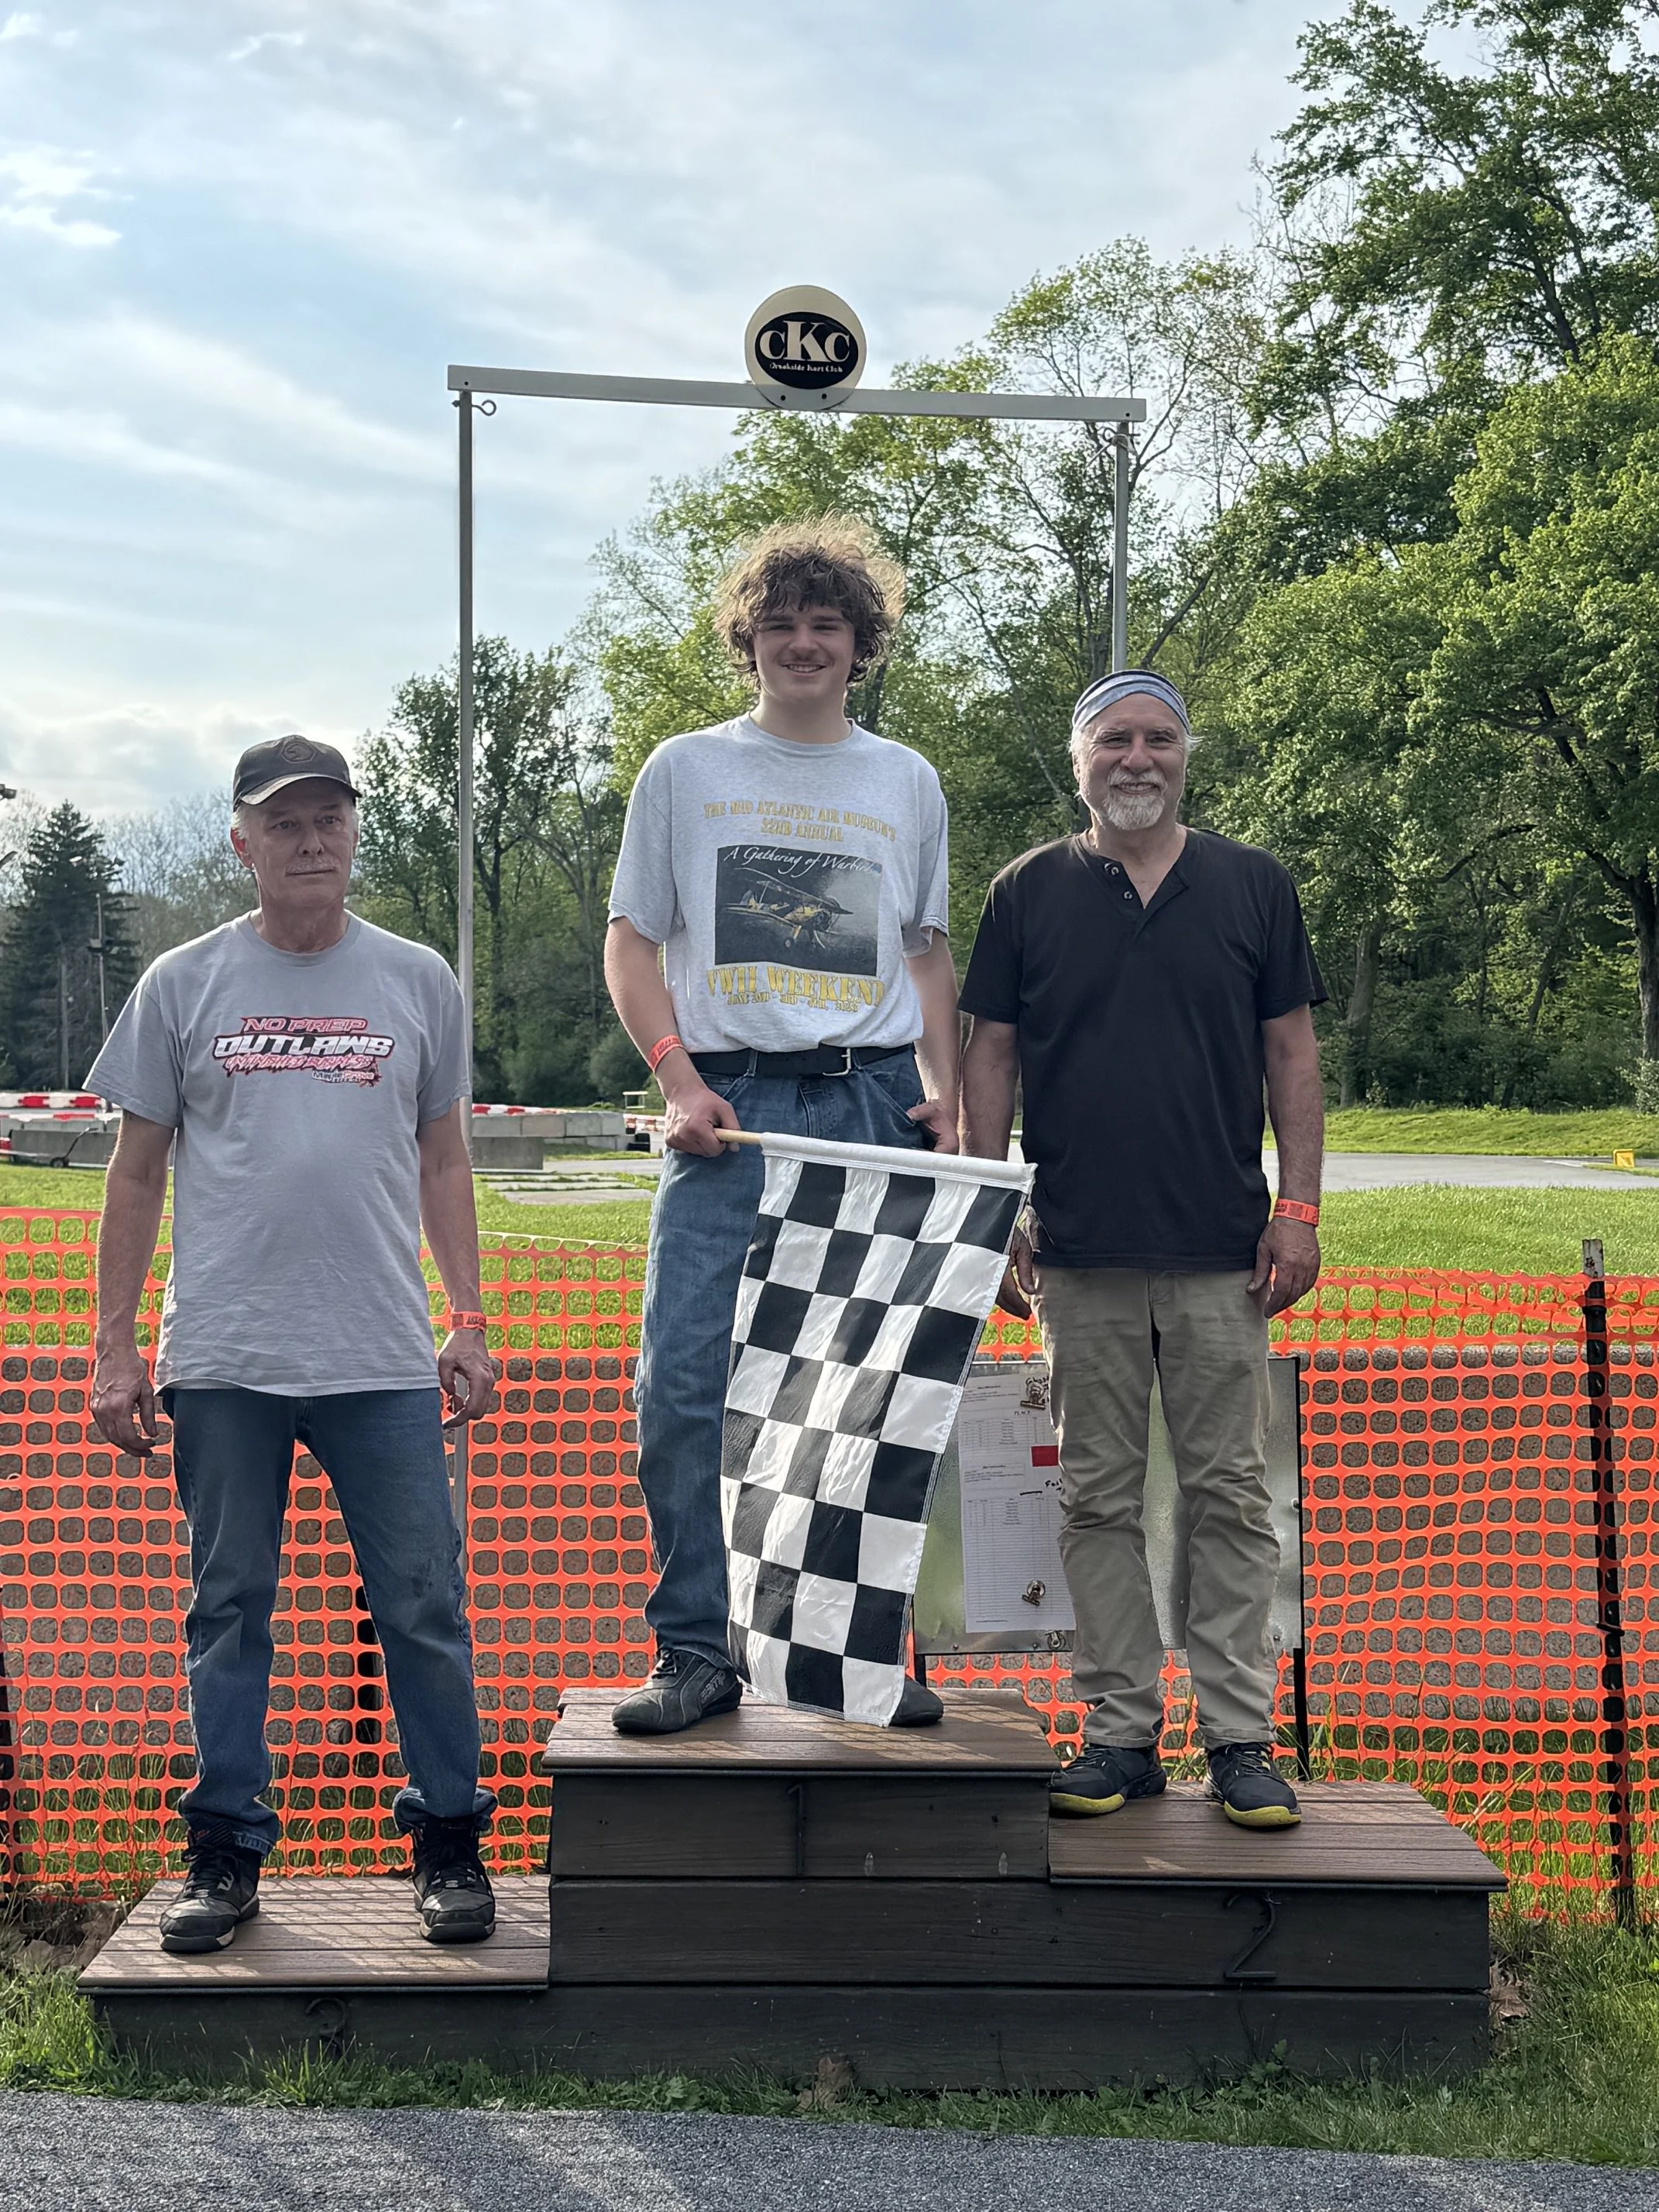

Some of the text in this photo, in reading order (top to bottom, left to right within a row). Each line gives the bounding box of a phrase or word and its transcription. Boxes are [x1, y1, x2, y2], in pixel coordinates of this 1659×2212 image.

[817, 808, 840, 823] AIR
[795, 823, 843, 842] ANNUAL
[724, 846, 739, 861] A
[742, 847, 803, 874] Gathering
[791, 853, 823, 878] of
[243, 1017, 368, 1032] NO PREP
[213, 1035, 394, 1058] OUTLAWS
[1224, 1891, 1276, 1979] 2
